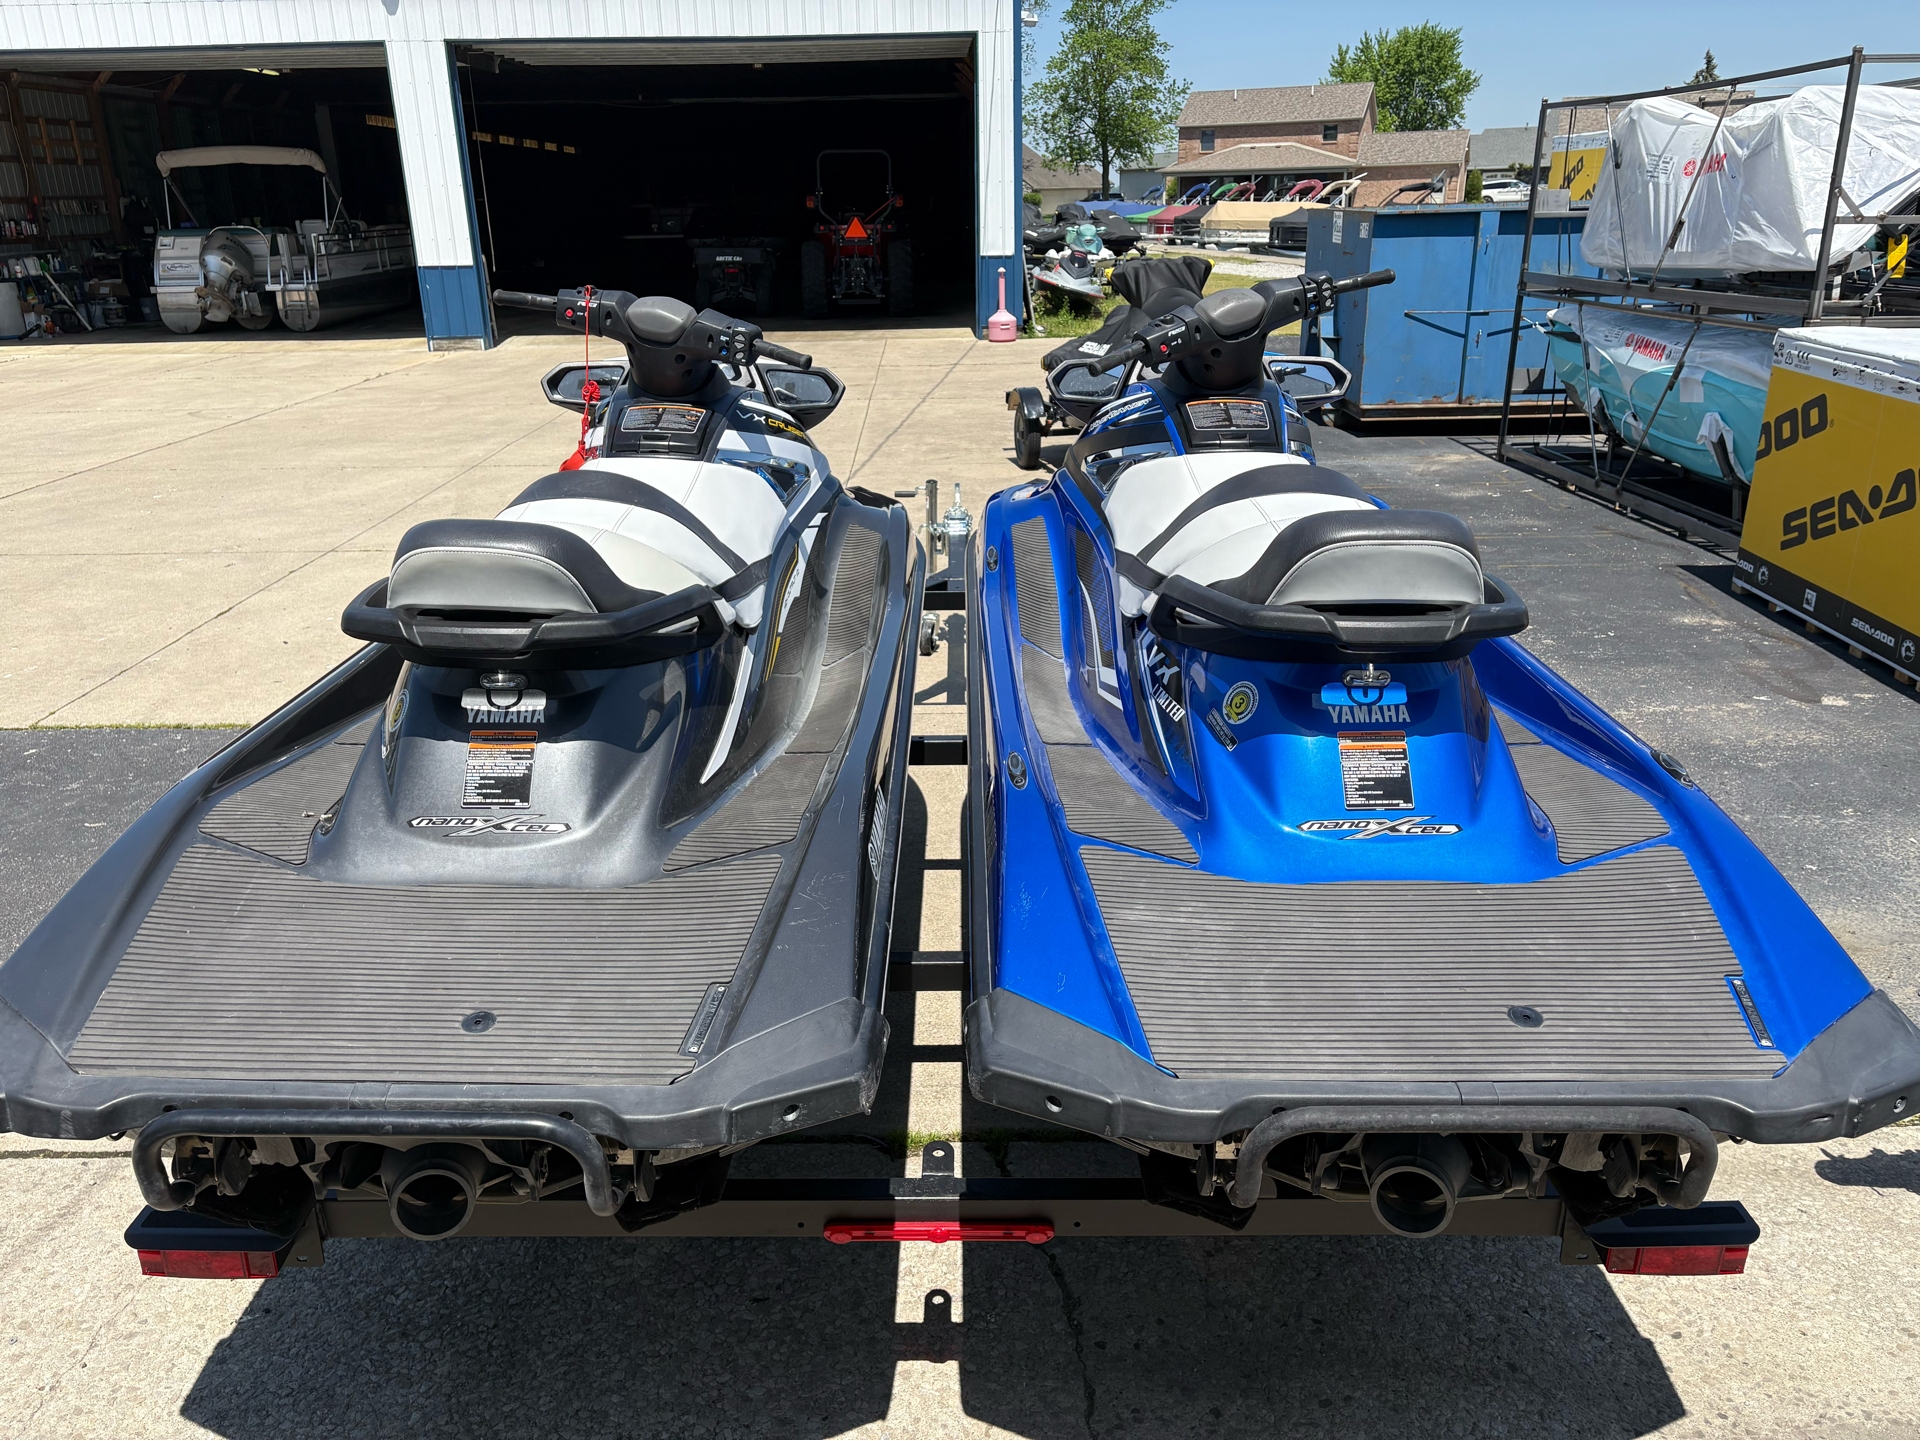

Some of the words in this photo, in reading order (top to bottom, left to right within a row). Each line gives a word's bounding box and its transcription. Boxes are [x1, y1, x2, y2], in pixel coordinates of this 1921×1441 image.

[1633, 334, 1667, 362] YAMAHA
[736, 409, 766, 424] VX
[1147, 644, 1181, 686] VX
[1151, 683, 1186, 722] LIMITED
[467, 706, 545, 724] YAMAHA
[1328, 705, 1412, 724] YAMAHA
